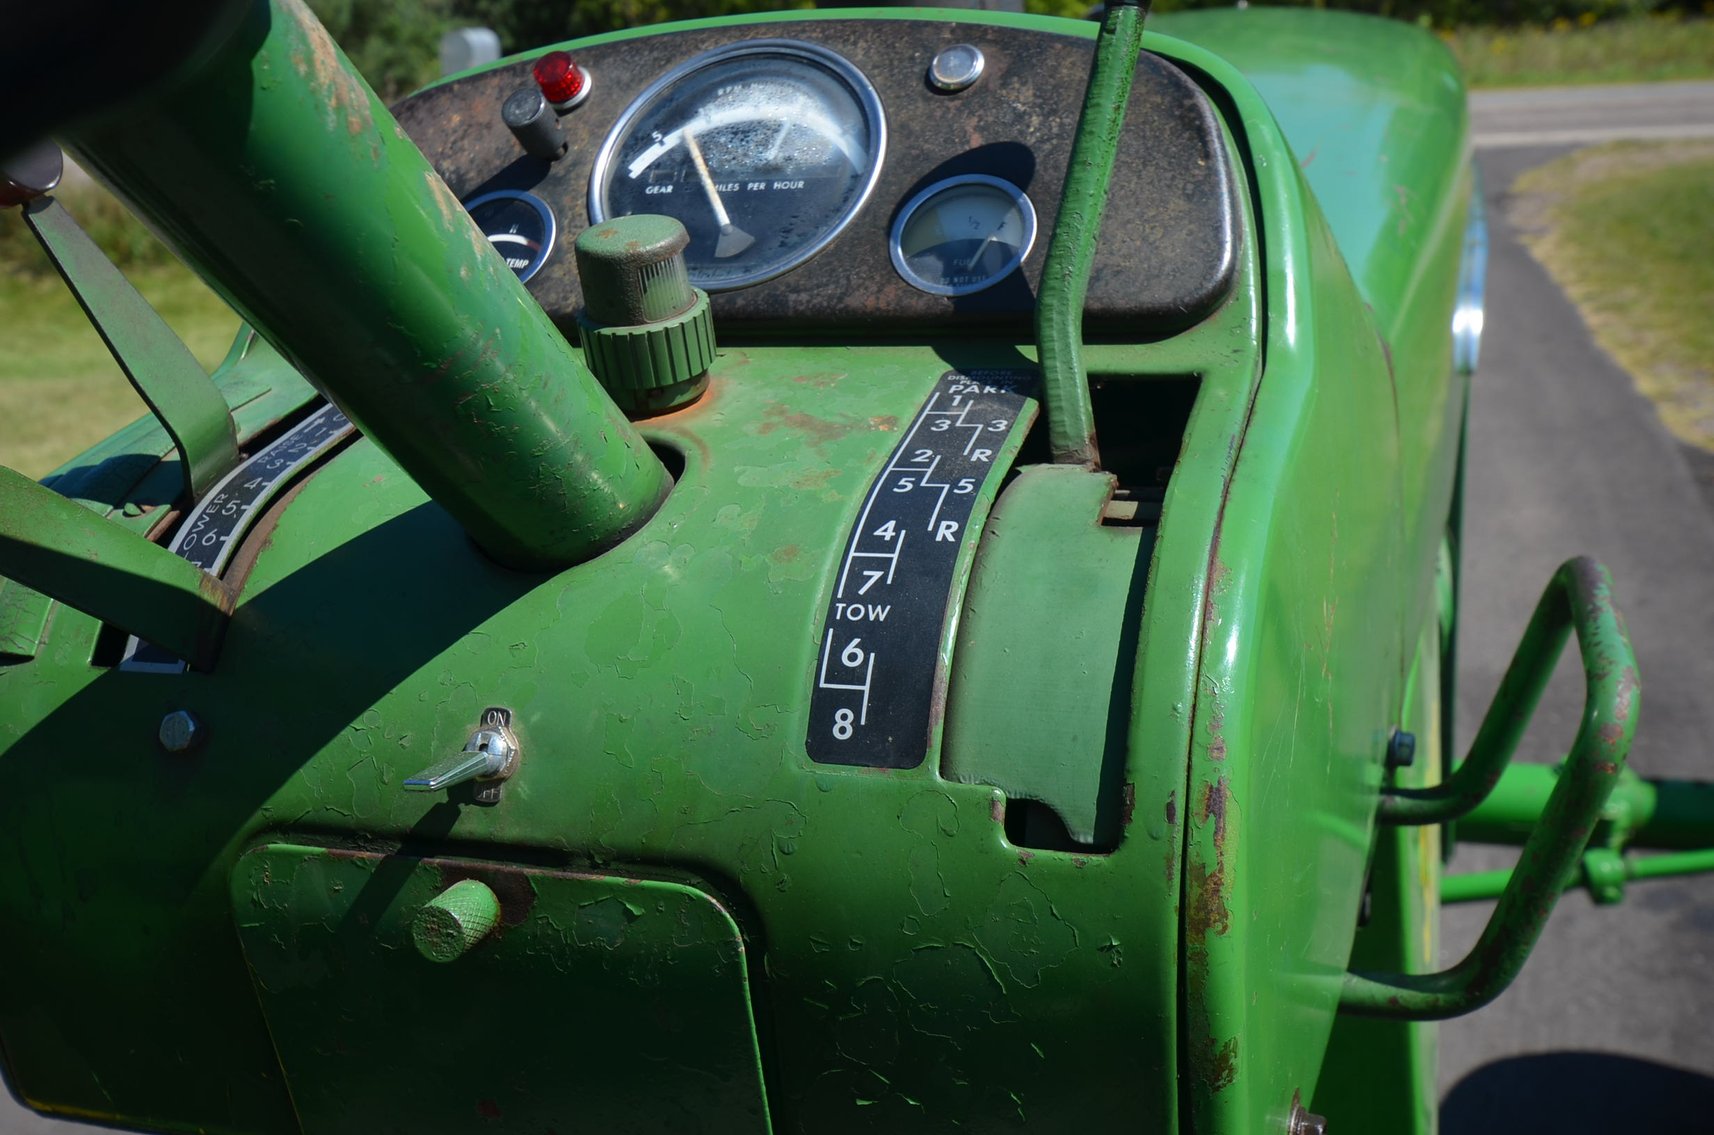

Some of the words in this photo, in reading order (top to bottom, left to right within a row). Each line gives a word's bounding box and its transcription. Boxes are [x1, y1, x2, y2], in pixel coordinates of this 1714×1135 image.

[651, 131, 663, 142] 5
[645, 185, 674, 194] GEAR
[747, 182, 766, 191] PER
[773, 181, 805, 190] HOUR
[506, 257, 529, 269] TEMP
[951, 395, 963, 407] 1
[930, 419, 951, 432] 3
[987, 419, 1009, 432] 3
[288, 442, 307, 454] 2
[911, 449, 933, 462] 2
[970, 449, 993, 462] R
[266, 458, 284, 470] 3
[243, 476, 264, 490] 4
[891, 477, 915, 493] 5
[953, 478, 976, 494] 5
[221, 499, 242, 516] 5
[201, 528, 219, 547] 6
[873, 520, 897, 541] 4
[935, 521, 959, 542] R
[857, 570, 885, 595] 7
[835, 603, 891, 622] TOW
[841, 638, 864, 668] 6
[487, 710, 507, 727] ON
[832, 708, 855, 741] 8
